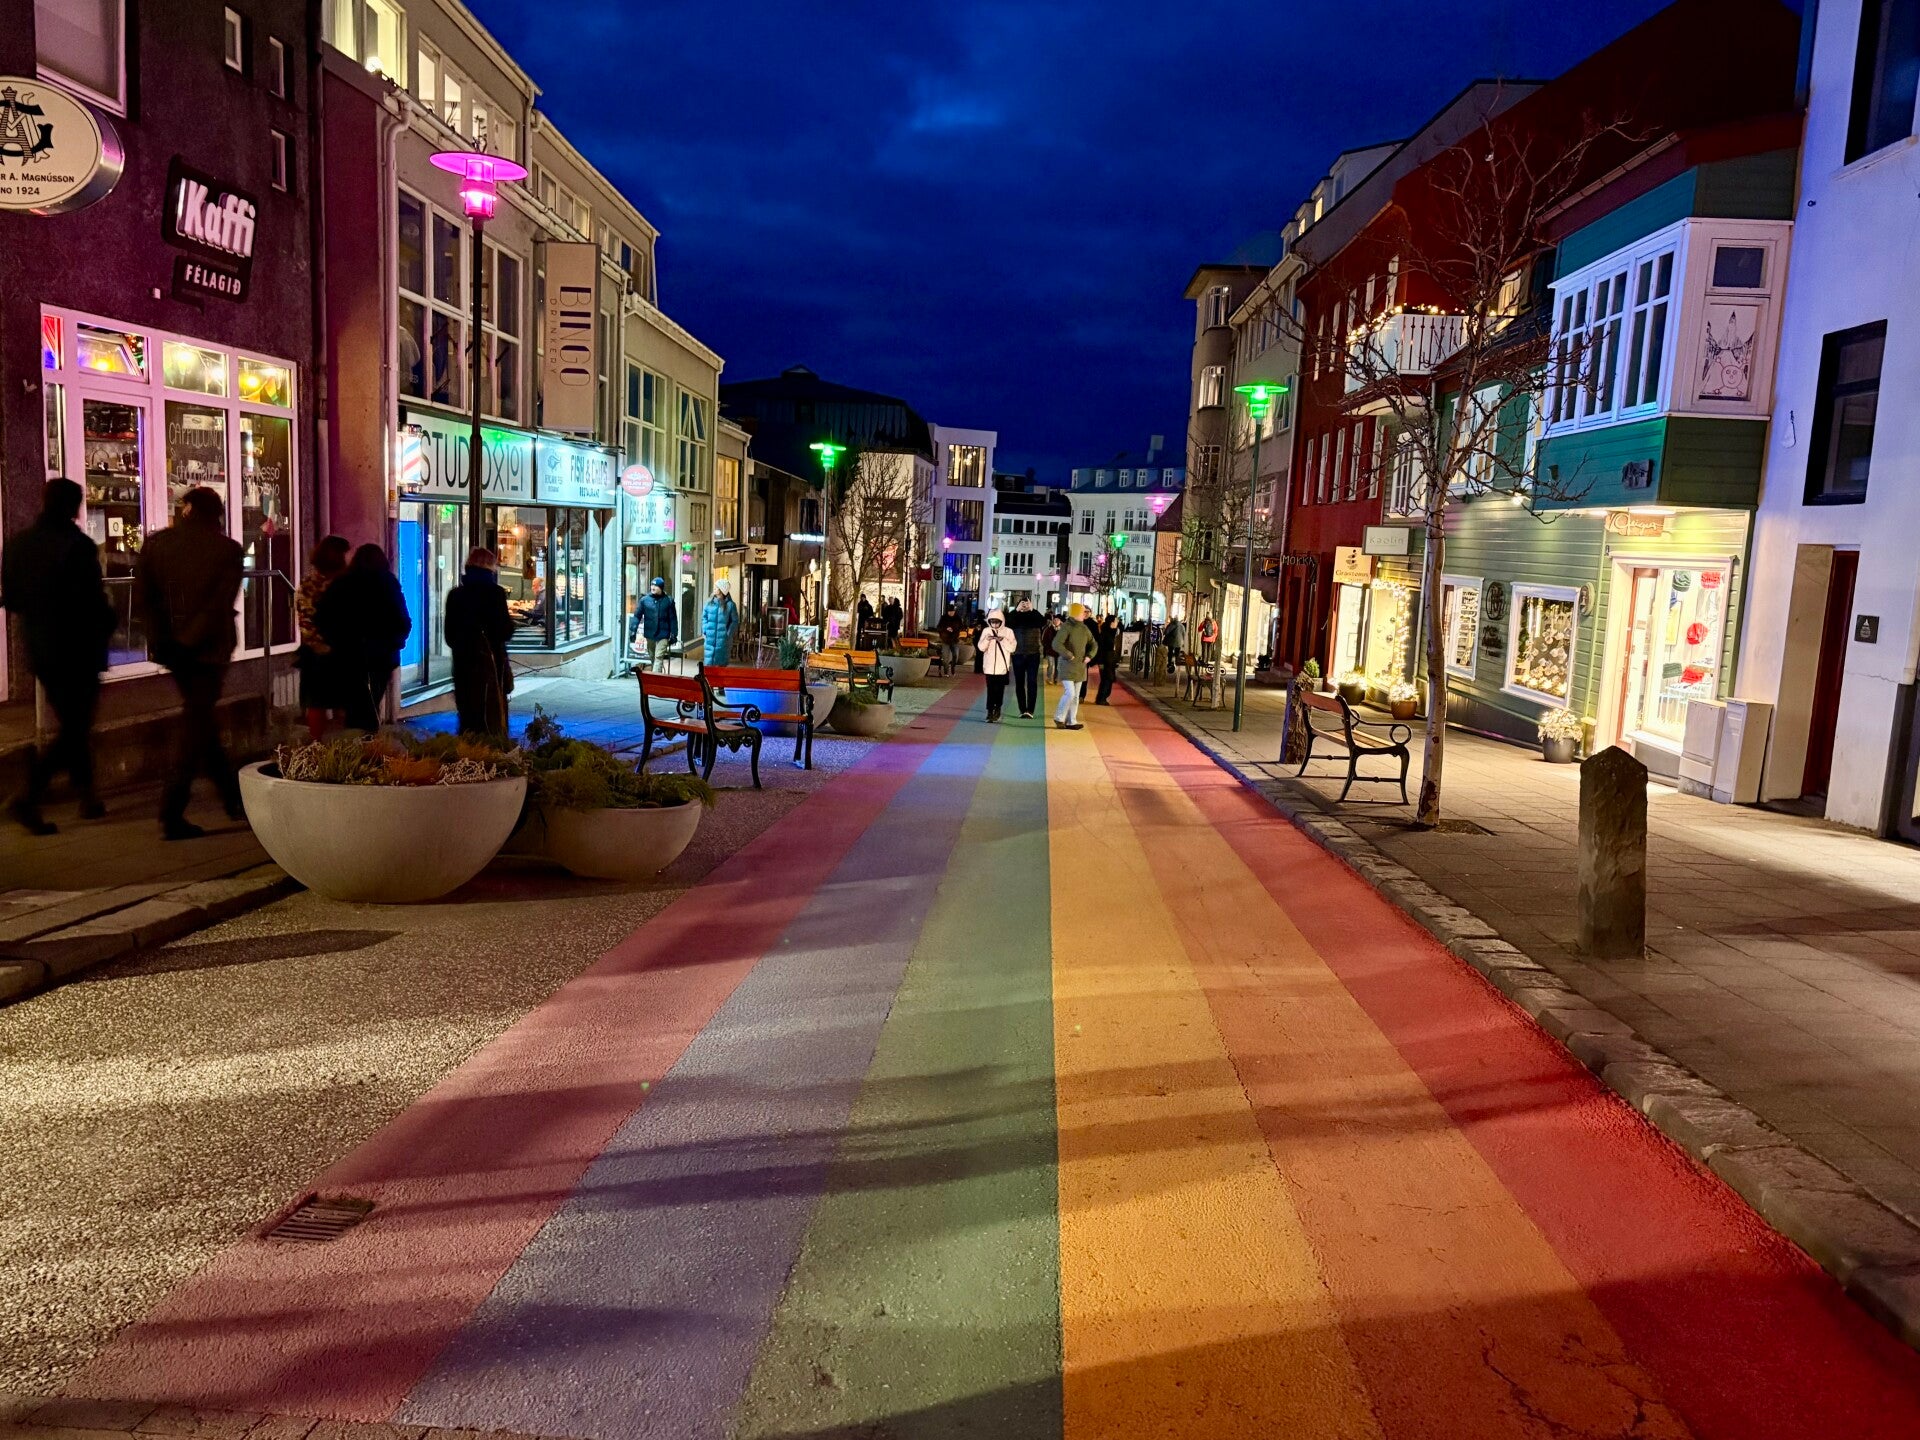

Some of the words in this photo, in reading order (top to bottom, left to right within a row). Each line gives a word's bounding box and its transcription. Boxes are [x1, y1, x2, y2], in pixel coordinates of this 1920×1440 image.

[9, 172, 18, 181] A.
[17, 186, 40, 195] 1924
[177, 177, 256, 258] Kaffi
[185, 263, 242, 295] FÉLAGIÐ
[549, 298, 558, 375] DRINKERY
[559, 286, 592, 386] BINGO
[571, 454, 585, 484] FISH
